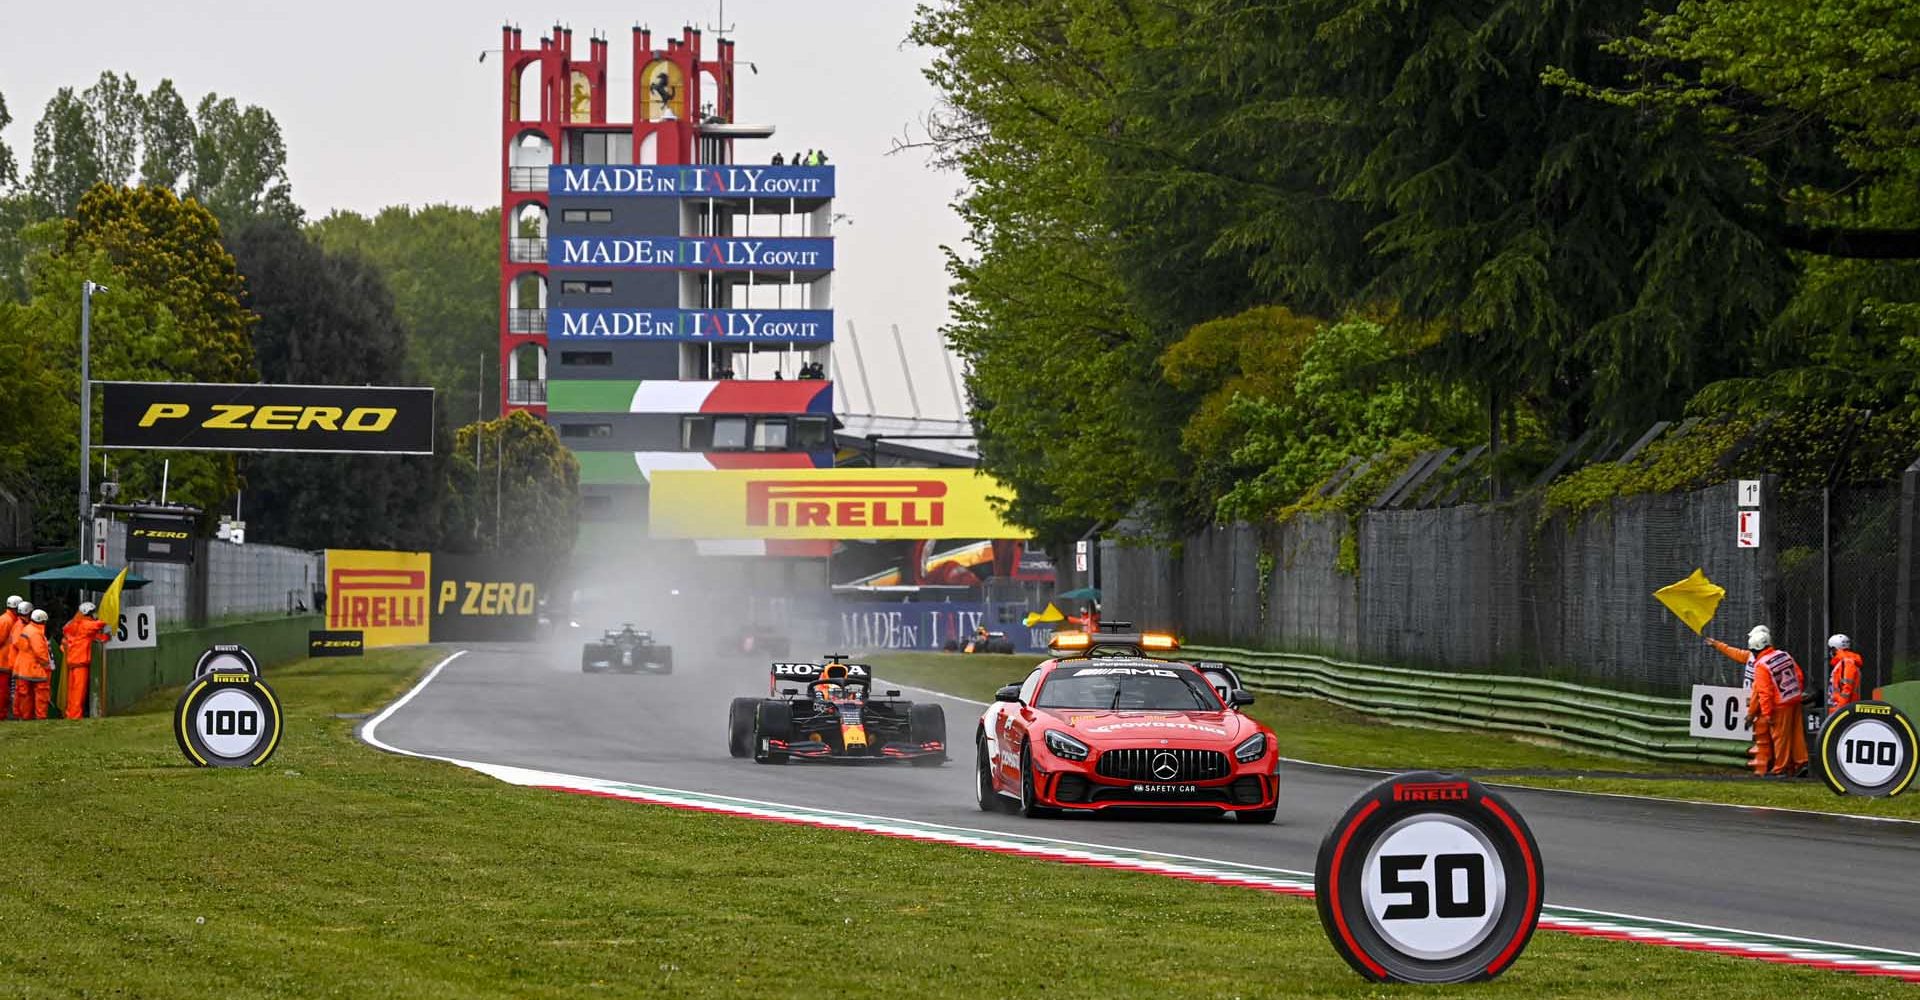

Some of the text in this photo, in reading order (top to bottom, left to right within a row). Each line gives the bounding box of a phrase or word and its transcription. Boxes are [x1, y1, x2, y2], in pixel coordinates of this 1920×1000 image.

[563, 169, 653, 192] MADE
[657, 178, 675, 192] IN
[563, 240, 653, 264] MADE
[656, 250, 673, 264] IN
[562, 313, 653, 336] MADE
[656, 322, 673, 336] IN
[138, 403, 397, 431] P ZERO
[746, 480, 947, 526] PIRELLI
[145, 530, 188, 539] ZERO
[331, 569, 425, 628] PIRELLI
[438, 580, 535, 615] P ZERO
[840, 612, 901, 648] MADE
[902, 626, 917, 647] IN
[213, 673, 249, 682] PIRELLI
[775, 664, 867, 675] HOA
[1856, 704, 1891, 715] PIRELLI
[204, 710, 257, 735] 100
[1845, 739, 1897, 766] 100
[1393, 781, 1469, 801] PIRELLI
[1379, 853, 1486, 920] 50
